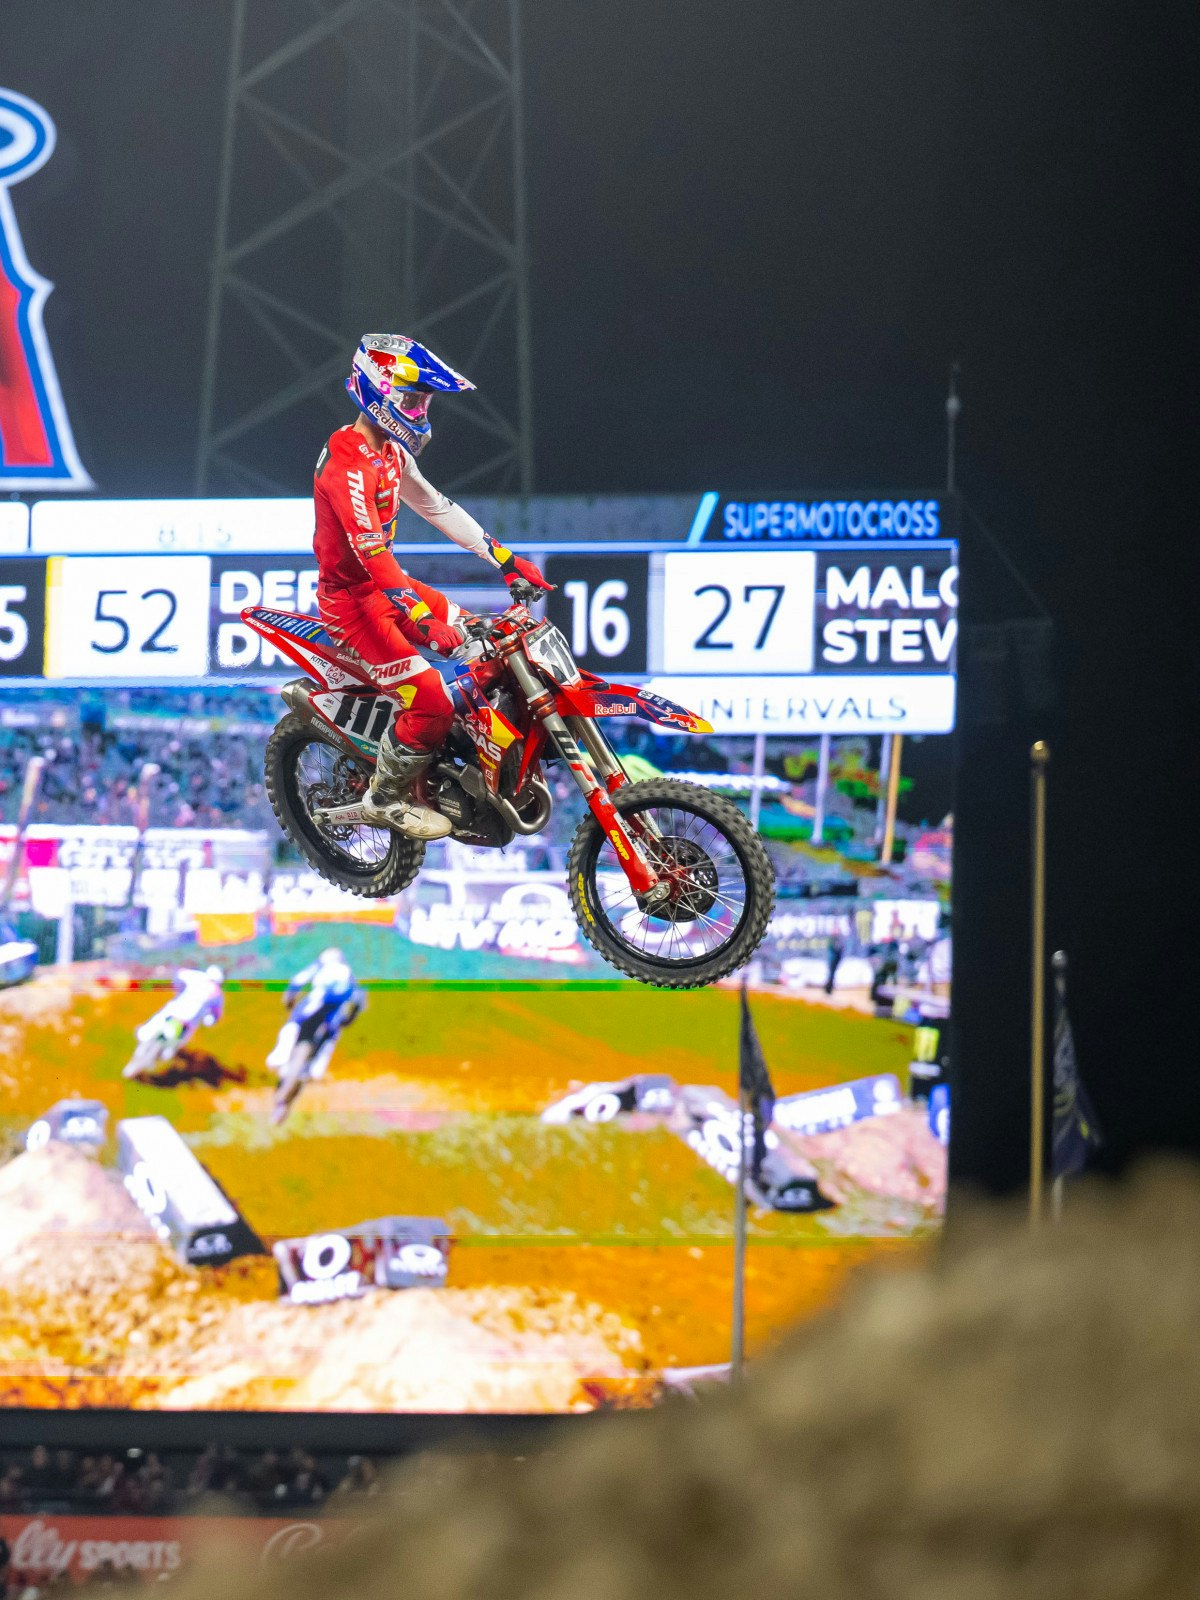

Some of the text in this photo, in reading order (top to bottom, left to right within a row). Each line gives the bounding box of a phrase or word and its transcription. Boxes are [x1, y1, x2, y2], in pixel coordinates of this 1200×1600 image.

[347, 470, 373, 530] THOR
[724, 501, 940, 538] SUPERMOTOCROSS
[90, 588, 179, 654] 52
[246, 617, 276, 635] DUNLOP
[564, 580, 630, 657] 16
[693, 584, 786, 651] 27
[373, 658, 412, 680] THOR
[332, 693, 394, 743] 111
[594, 702, 637, 715] Red Bull
[701, 696, 907, 721] INTERVALS
[78, 1540, 181, 1570] SPORTS
